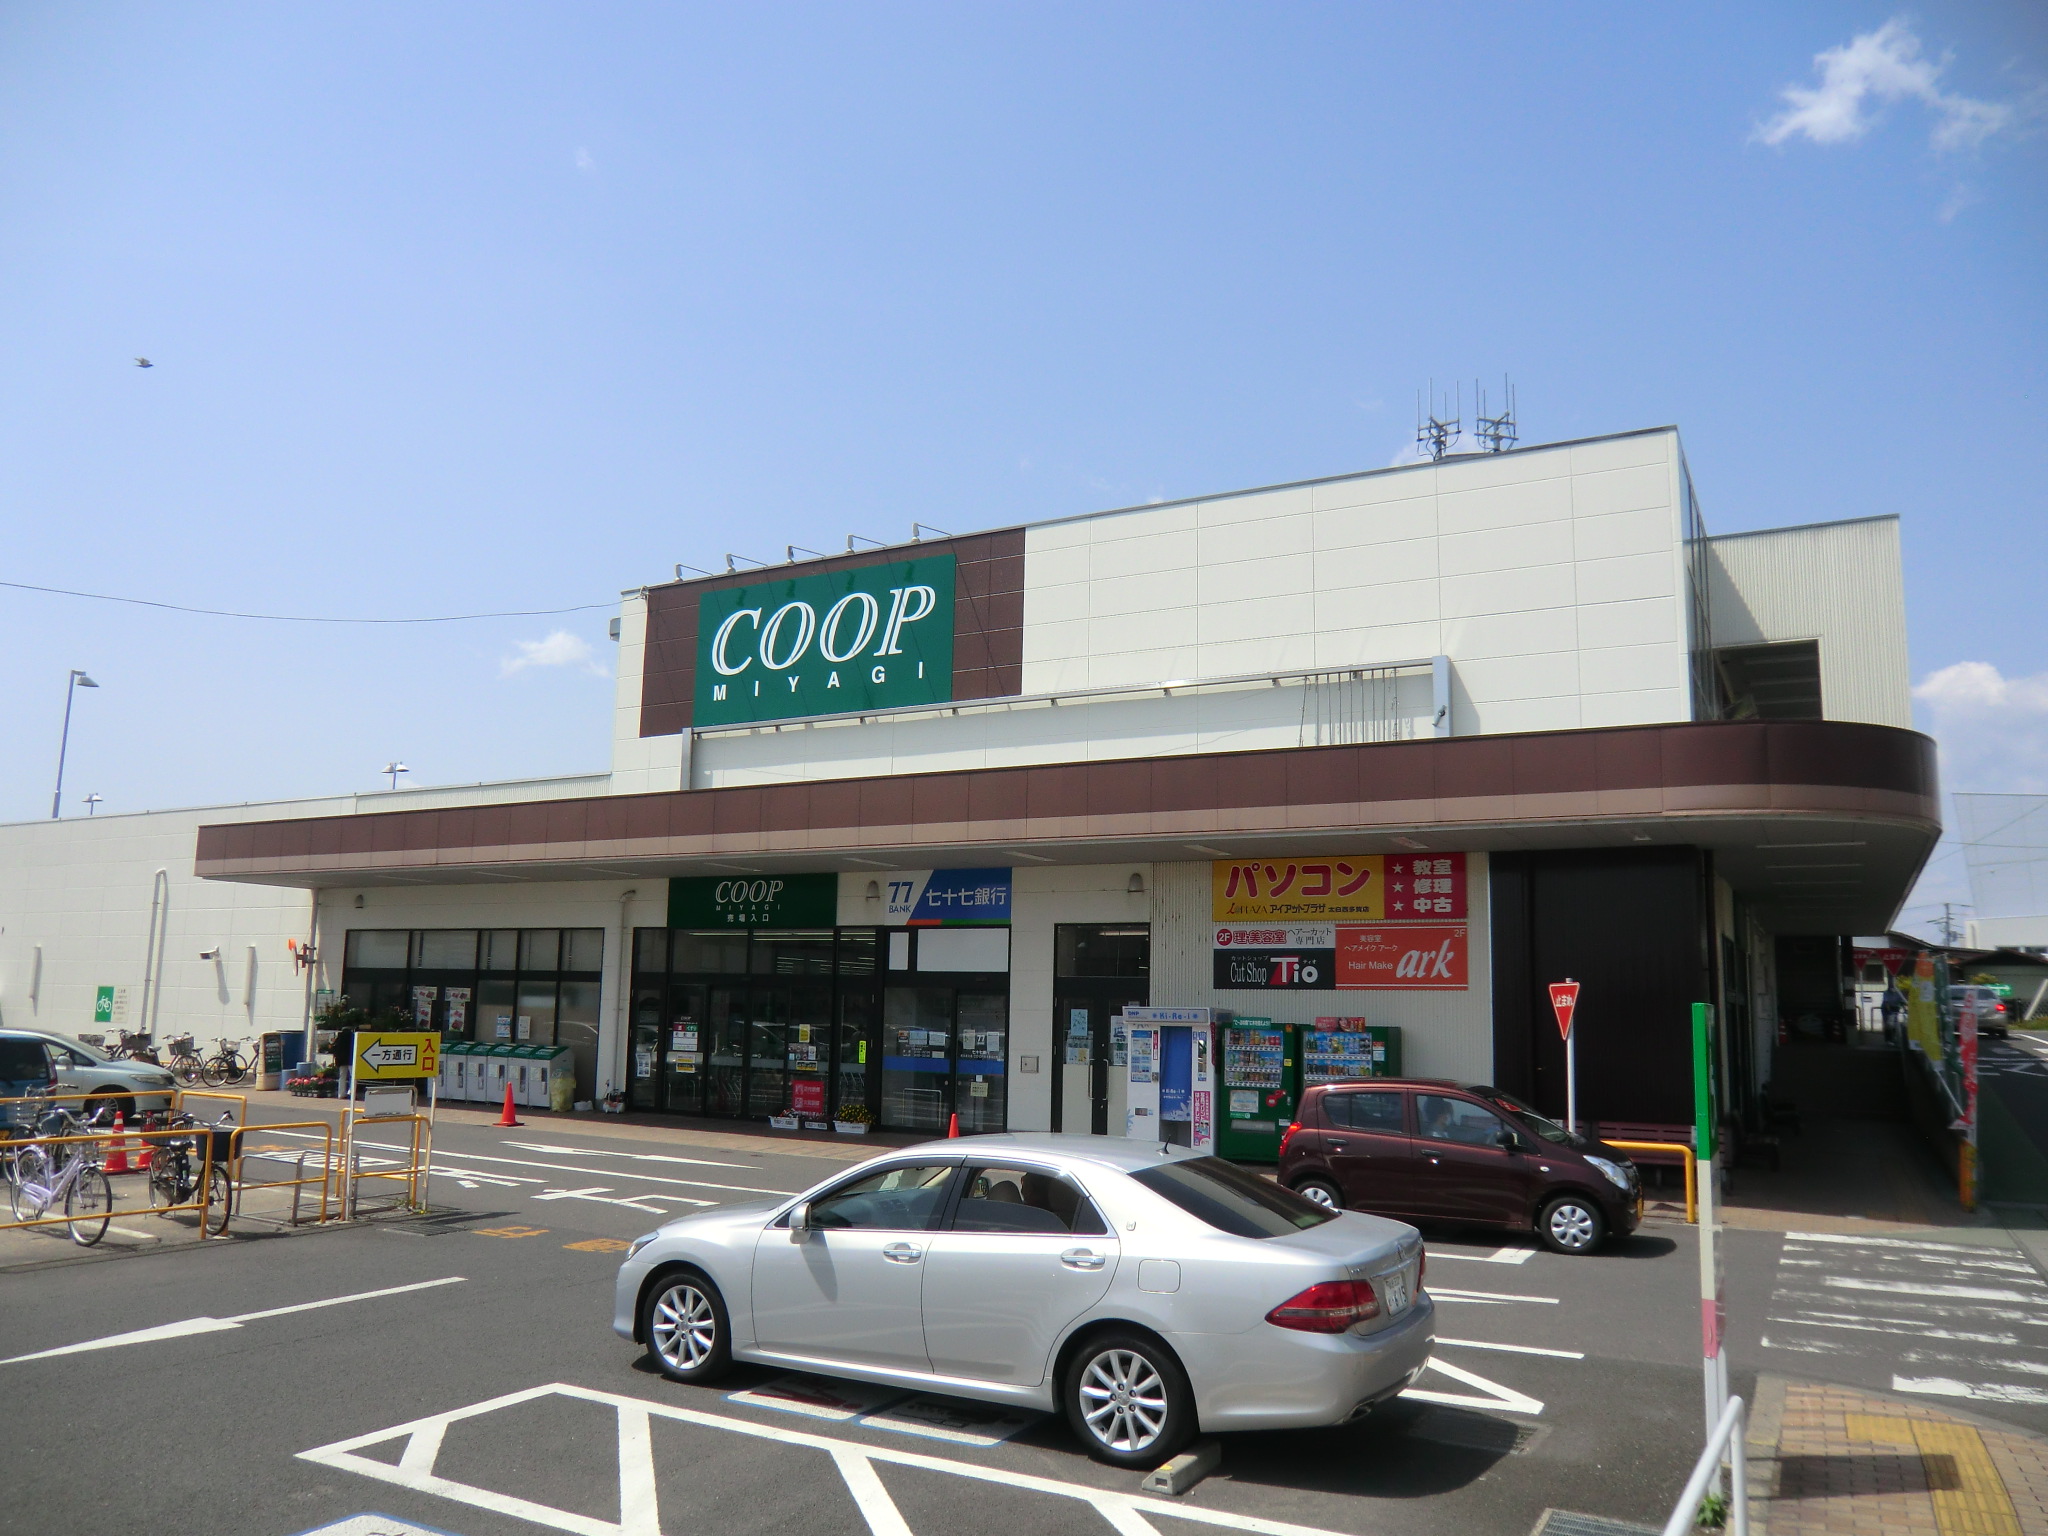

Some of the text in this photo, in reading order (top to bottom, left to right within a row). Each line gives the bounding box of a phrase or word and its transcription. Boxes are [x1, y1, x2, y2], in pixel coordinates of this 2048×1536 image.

[711, 585, 936, 676] COOP
[713, 661, 923, 701] MIYAGI
[1413, 859, 1452, 875] 教室
[1225, 862, 1370, 898] パソコン
[1413, 878, 1452, 894] 修理
[715, 880, 784, 903] COOP
[888, 882, 914, 903] 77
[926, 887, 1006, 906] 七十七銀行
[889, 905, 911, 913] BANK
[1413, 897, 1452, 913] 中古
[1218, 932, 1231, 942] 2F
[1288, 928, 1332, 936] ヘアーカット
[1454, 929, 1466, 938] 2F
[1296, 936, 1326, 945] 専門店
[1348, 961, 1393, 970] Hair Make
[1396, 939, 1455, 978] ark
[1230, 962, 1267, 985] Cut Shop
[1270, 957, 1318, 983] Tio
[1555, 995, 1573, 1007] 止まれ
[371, 1049, 413, 1061] 一方通行
[422, 1038, 436, 1072] 入口
